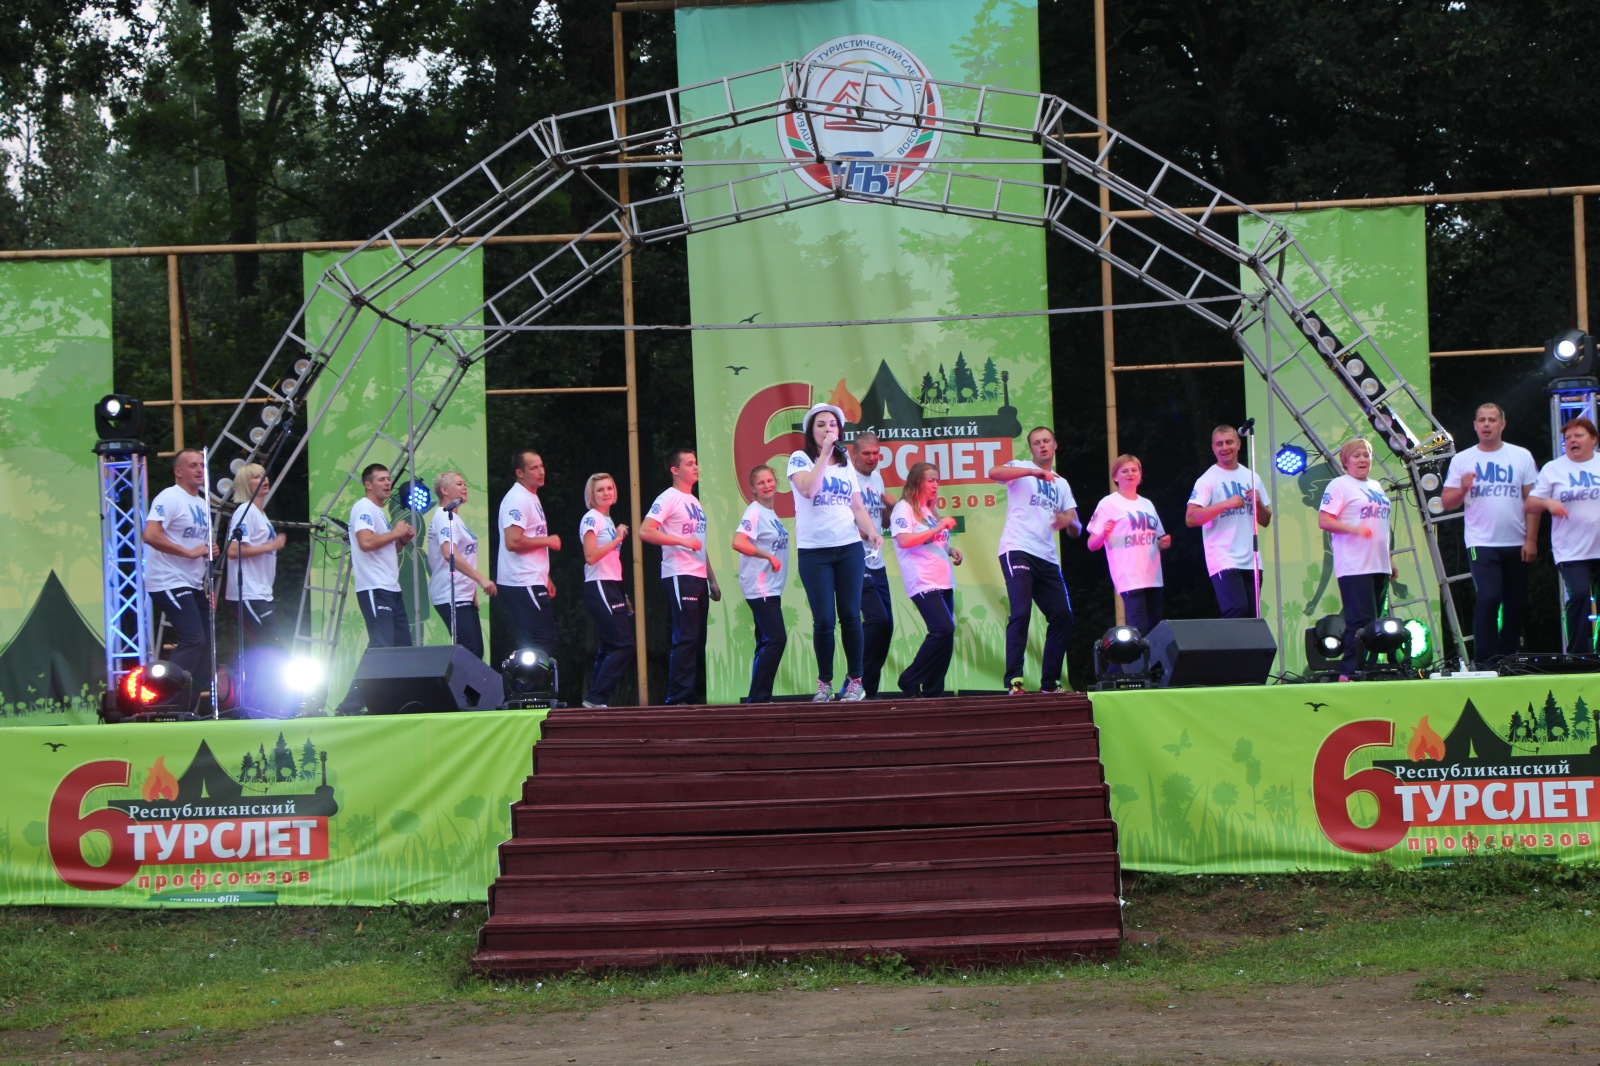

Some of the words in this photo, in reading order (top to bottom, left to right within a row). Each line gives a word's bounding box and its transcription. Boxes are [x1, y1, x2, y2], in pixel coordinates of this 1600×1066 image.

[817, 39, 903, 62] ТУРИСТИЧЕСКИЙ
[1474, 461, 1514, 484] МЫ
[1394, 759, 1571, 782] Республиканский
[1312, 716, 1412, 855] 6
[128, 800, 296, 820] Республиканский
[1393, 779, 1595, 822] ТУРСЛЕТ
[47, 757, 142, 891] 6
[126, 819, 318, 861] ТУРСЛЕТ
[1407, 830, 1591, 856] профсоюзов
[137, 868, 312, 893] профсоюзов
